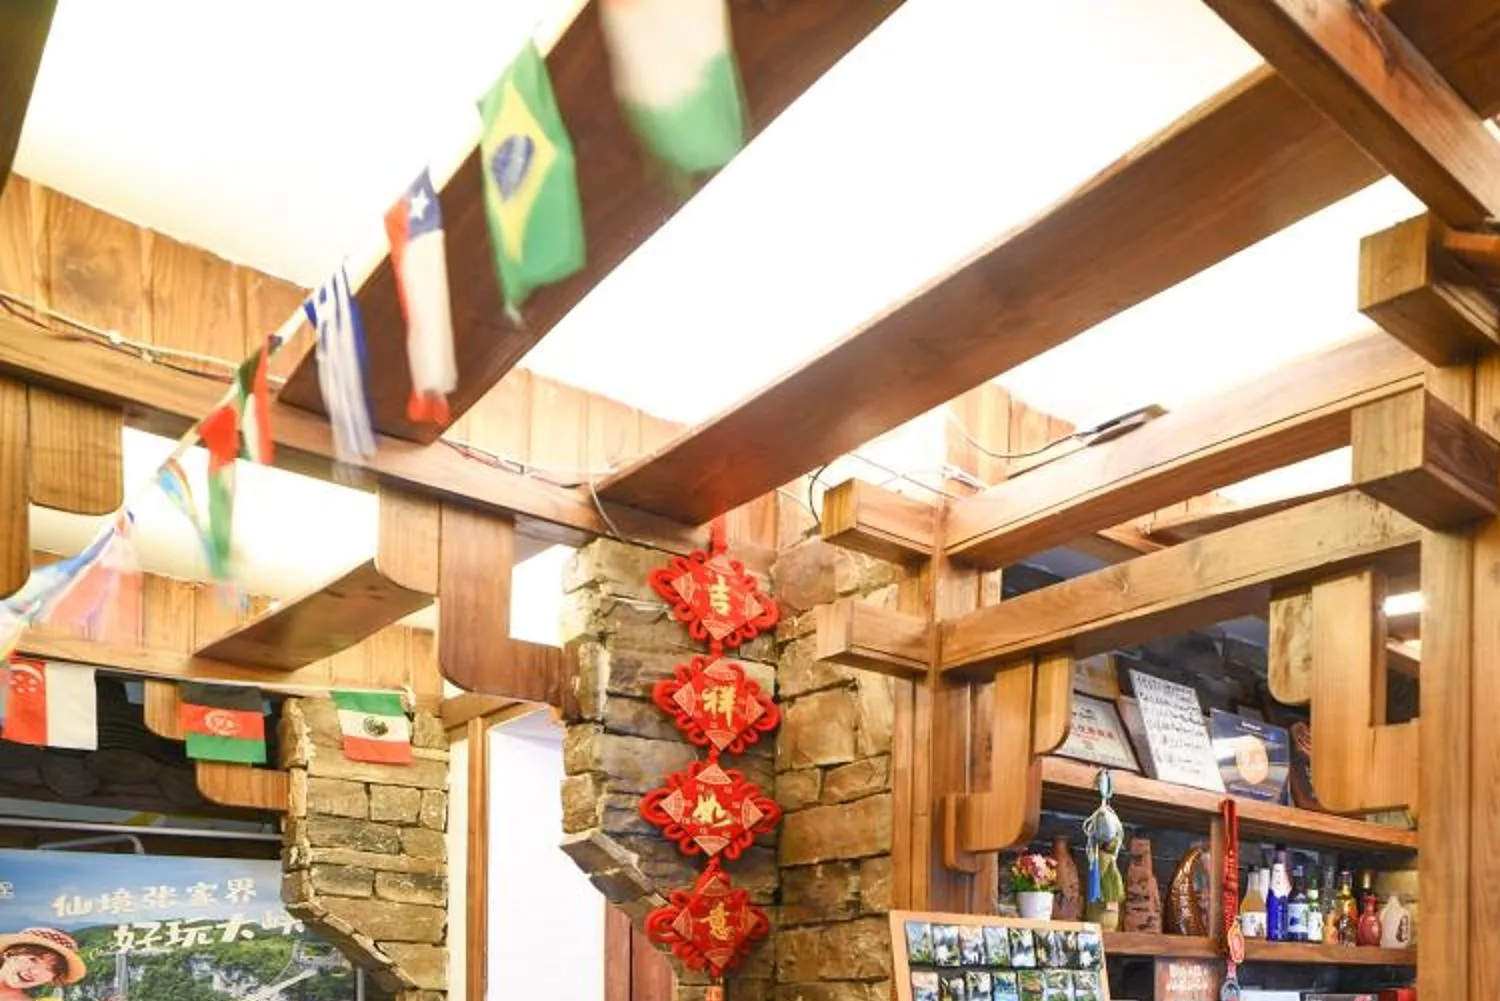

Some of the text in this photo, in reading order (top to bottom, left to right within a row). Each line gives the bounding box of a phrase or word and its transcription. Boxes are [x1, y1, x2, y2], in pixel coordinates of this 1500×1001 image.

[52, 877, 257, 917] 仙境张家界
